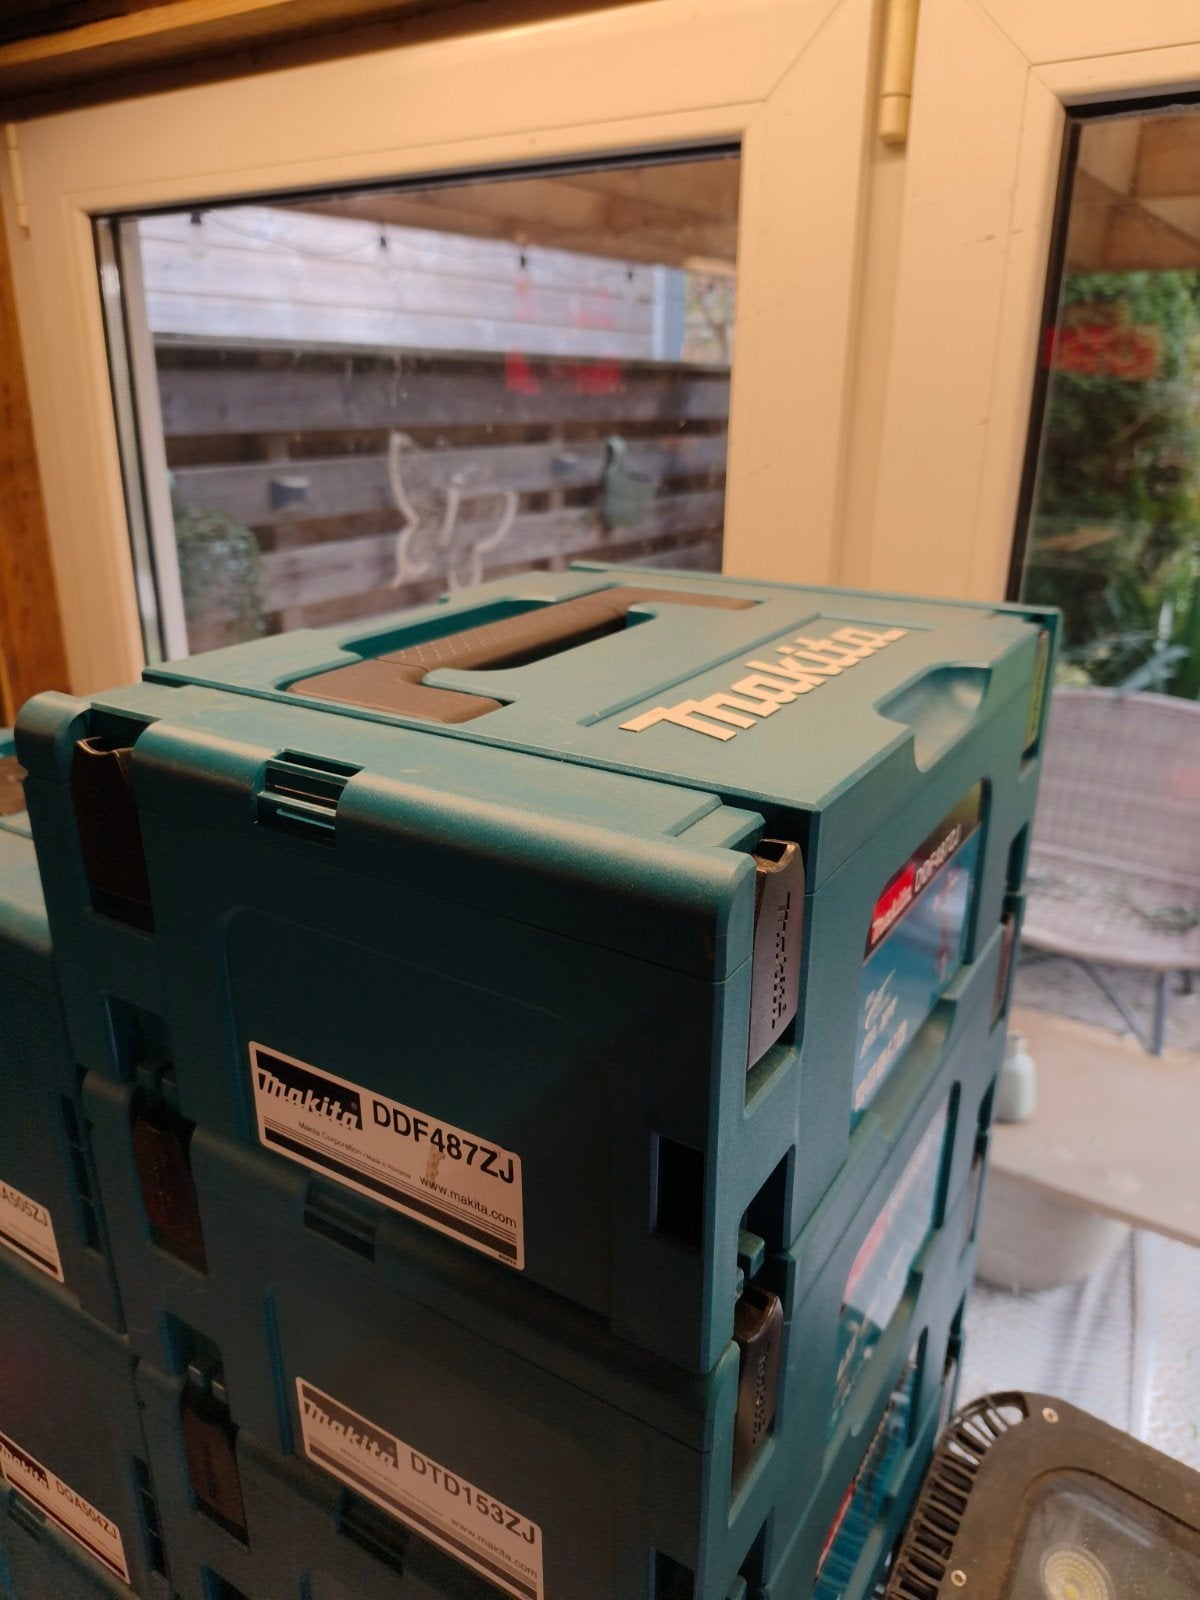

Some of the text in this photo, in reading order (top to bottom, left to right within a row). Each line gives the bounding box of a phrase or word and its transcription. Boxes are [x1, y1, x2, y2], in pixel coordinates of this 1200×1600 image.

[619, 626, 909, 742] makita
[257, 1068, 358, 1131] makita
[321, 1131, 363, 1156] Corporation
[372, 1099, 515, 1185] DDF487ZJ
[419, 1175, 517, 1229] www.makita.com
[303, 1397, 394, 1469] makita
[410, 1451, 536, 1545] DTD153ZJ
[450, 1517, 537, 1579] www.makita.com
